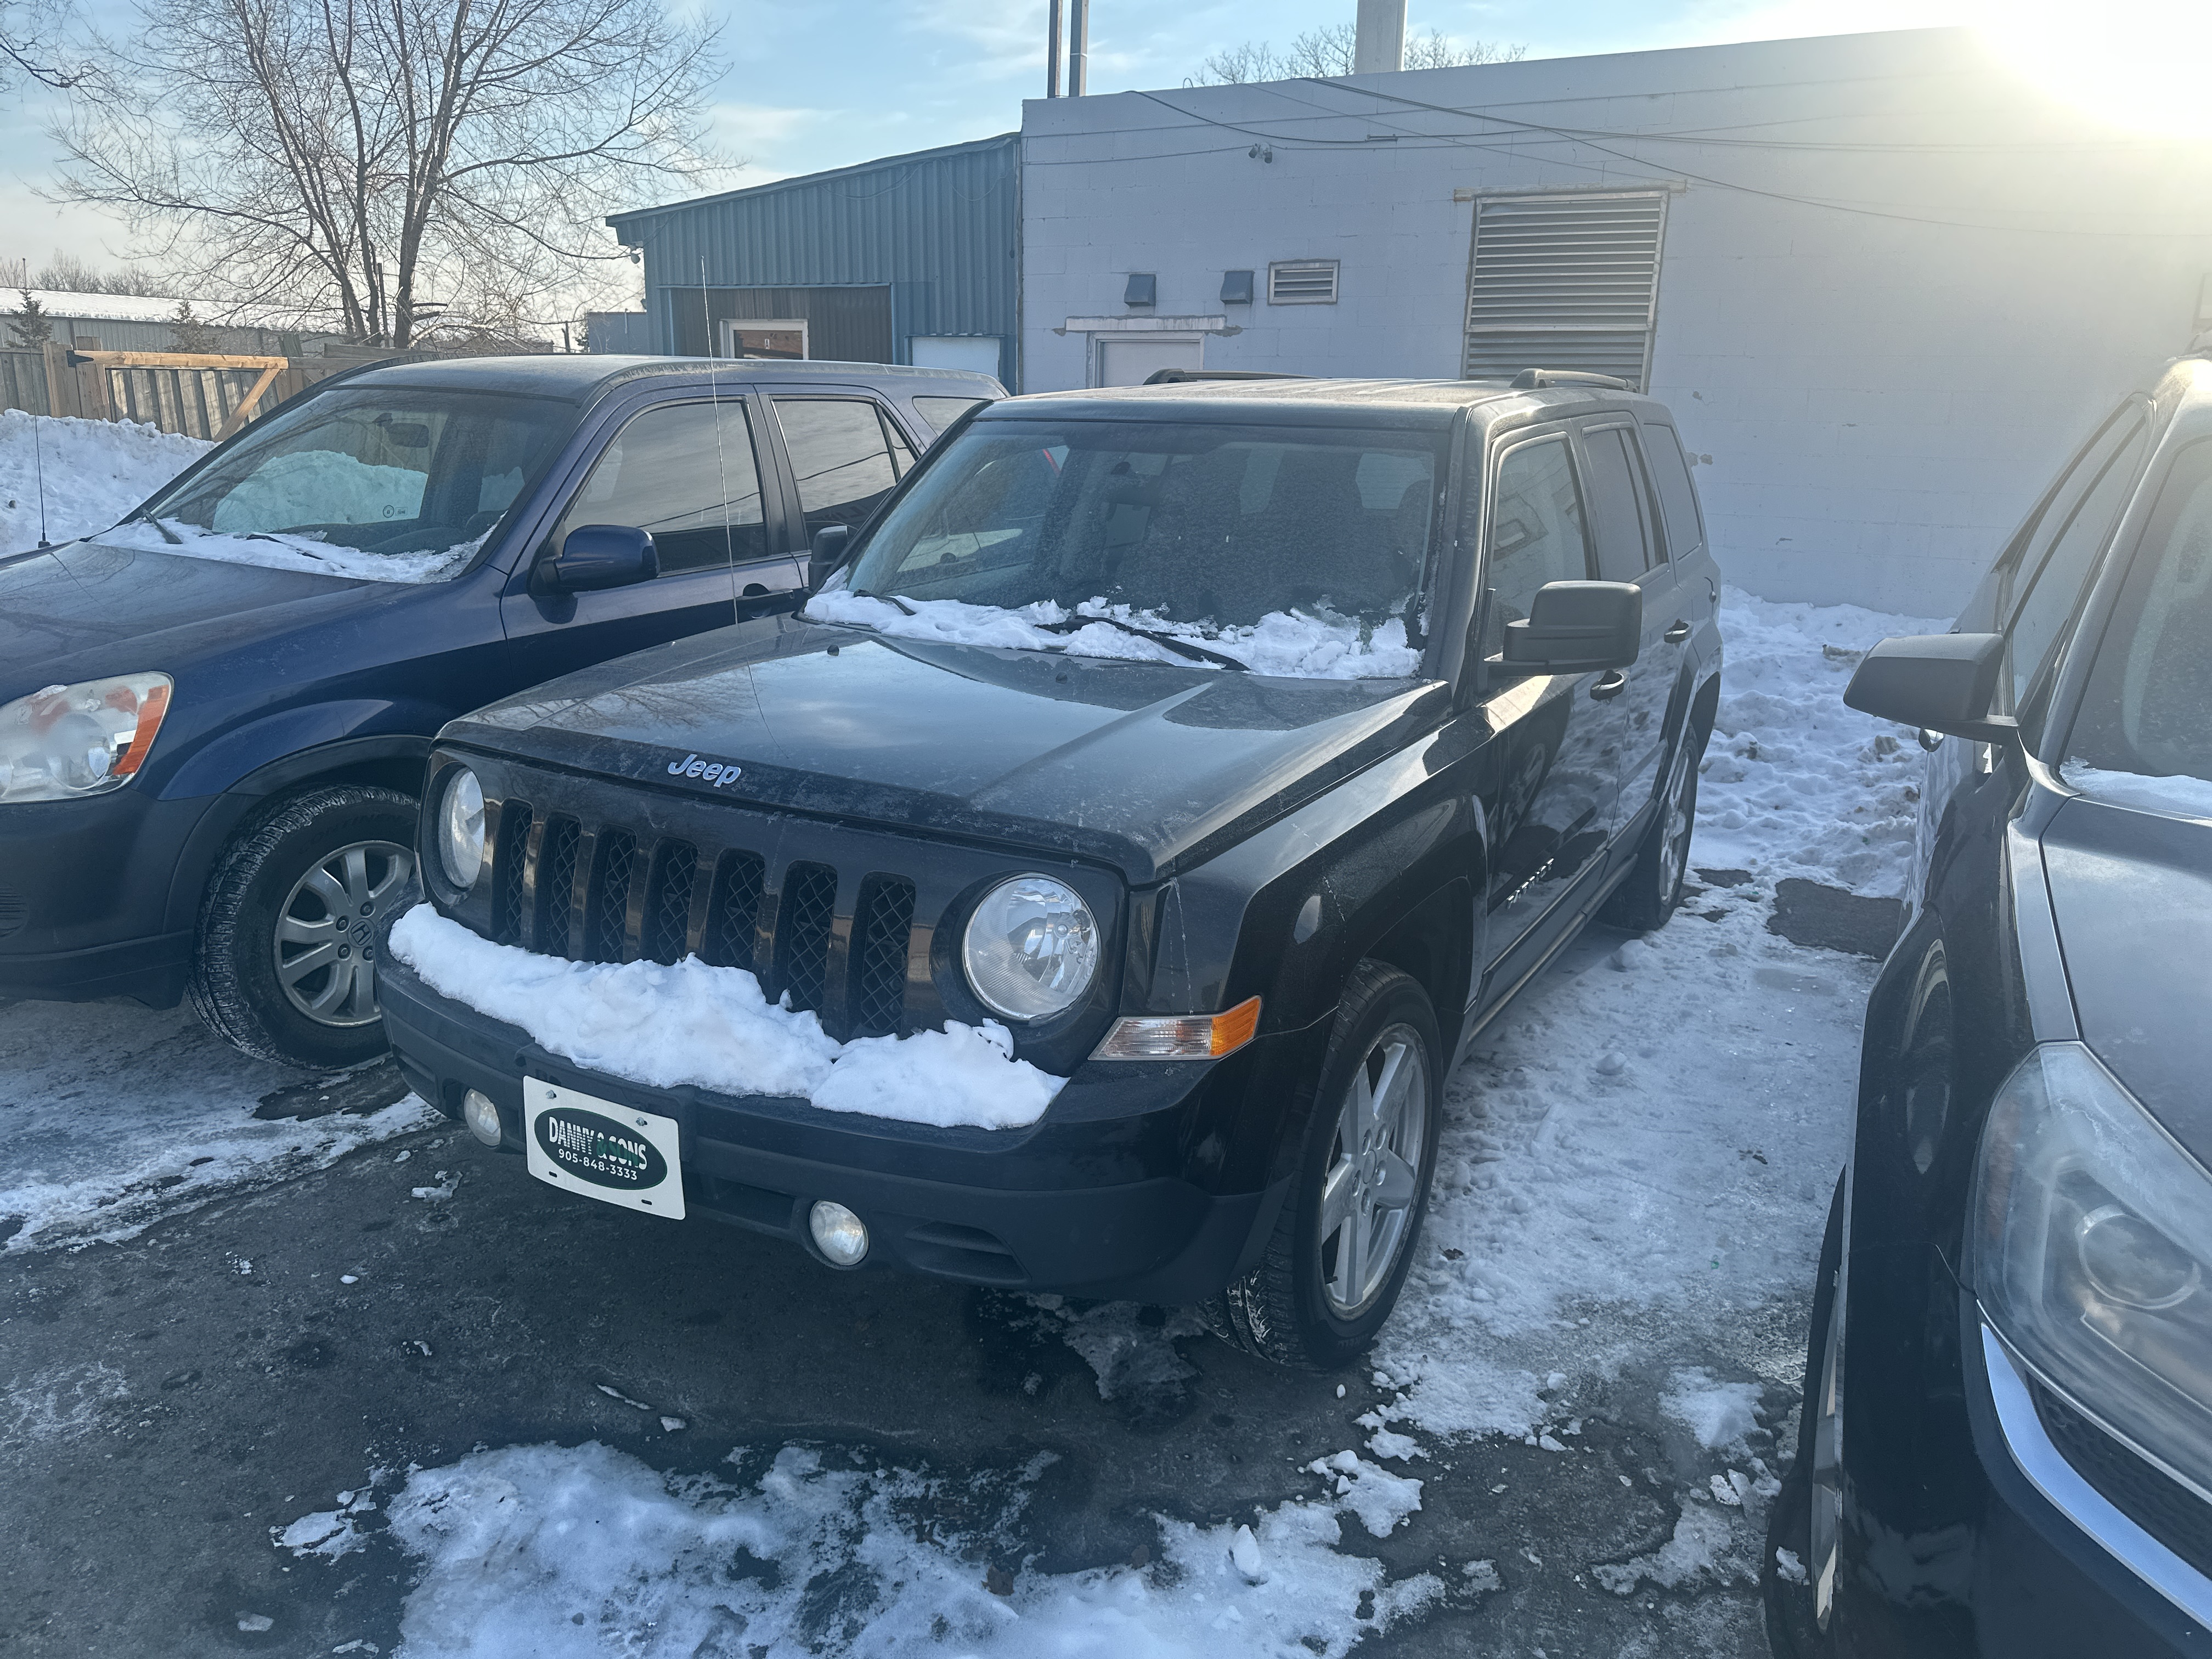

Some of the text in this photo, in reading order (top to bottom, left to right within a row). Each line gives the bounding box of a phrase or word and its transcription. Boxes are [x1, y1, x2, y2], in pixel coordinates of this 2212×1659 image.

[667, 753, 741, 788] Jeep
[549, 1116, 647, 1170] DANNY & SONS
[558, 1148, 637, 1180] 905-848-3333
